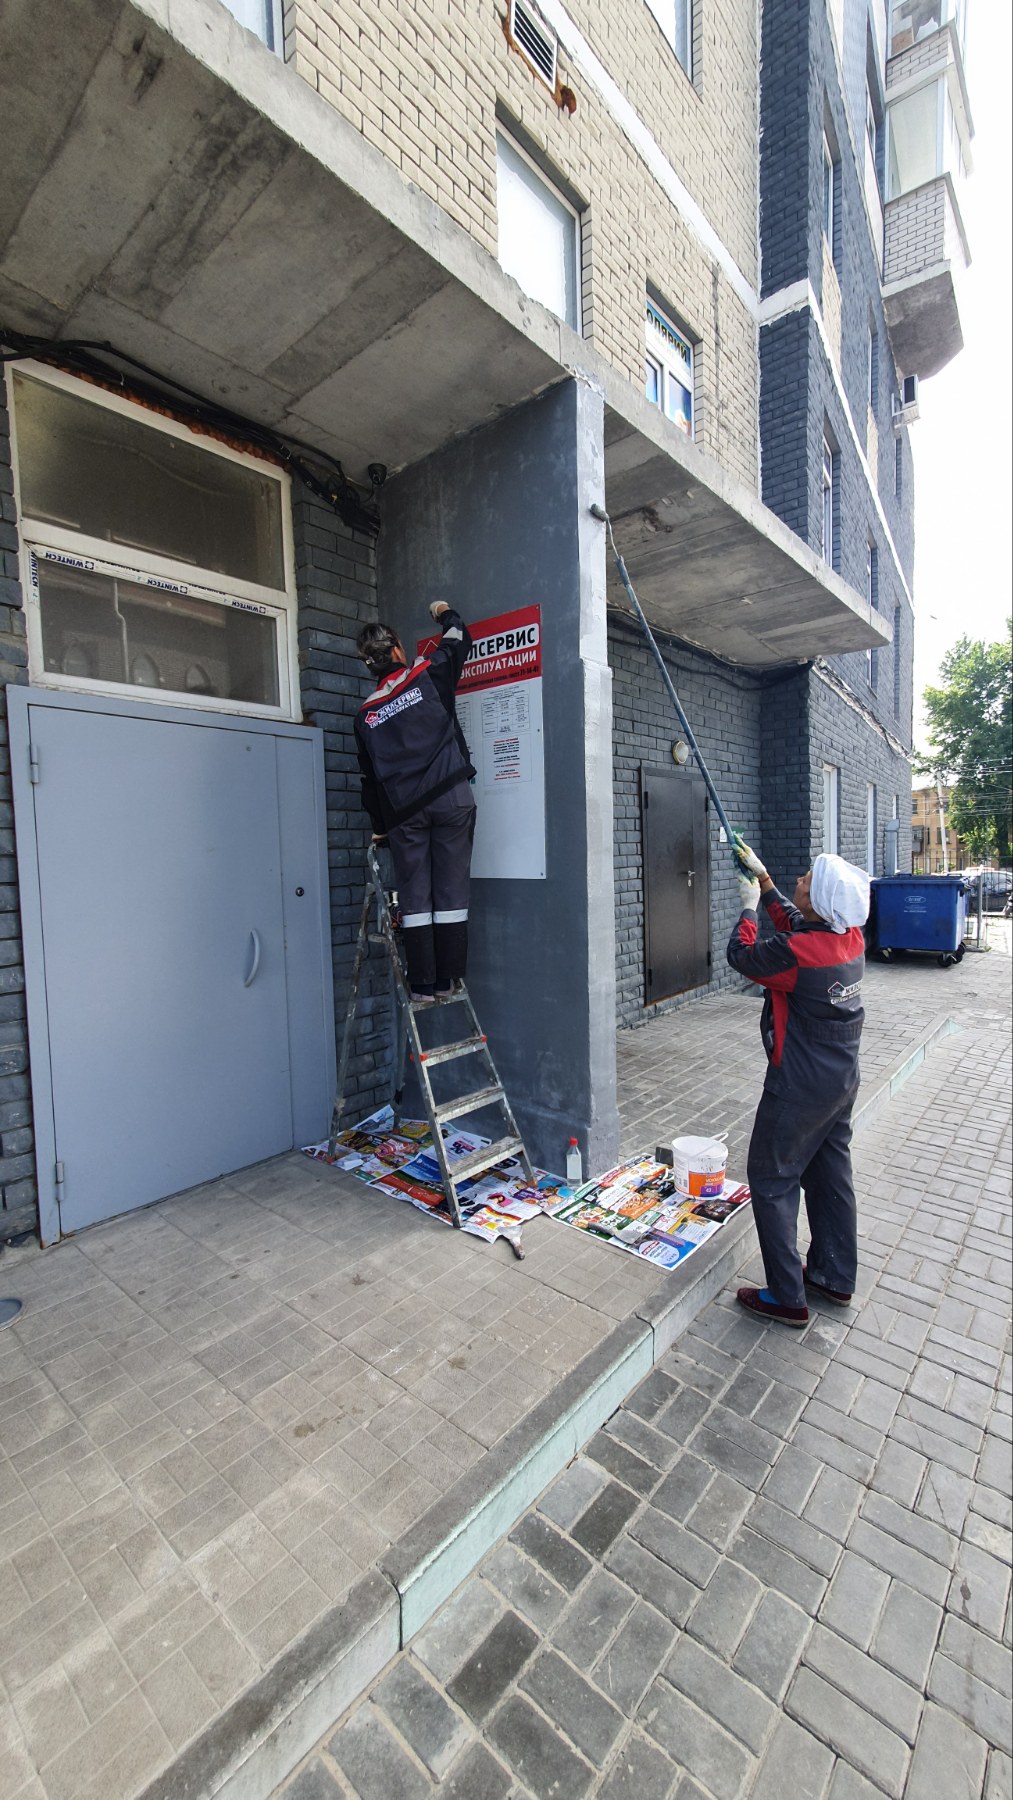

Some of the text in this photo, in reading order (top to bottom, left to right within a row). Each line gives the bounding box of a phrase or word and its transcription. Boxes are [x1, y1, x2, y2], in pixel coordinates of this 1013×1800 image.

[646, 307, 687, 363] ОЛЯРИЙ
[45, 552, 84, 568] WINTECH
[147, 579, 179, 592] WINTECH
[231, 600, 259, 612] WINTECH
[468, 627, 536, 661] ЛСЕРВИС
[460, 649, 537, 680] ЭКСПЛУАТАЦИИ
[379, 688, 420, 717] ЖИЛСЕРВИС
